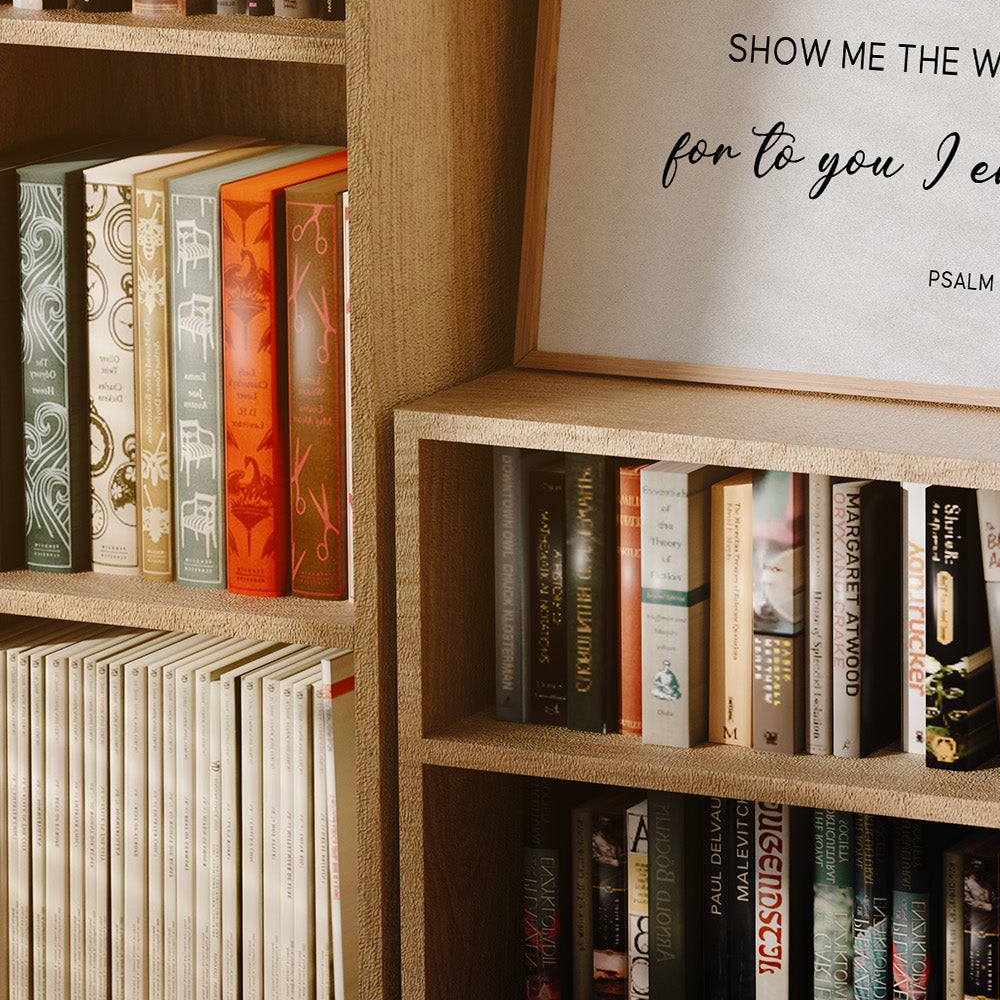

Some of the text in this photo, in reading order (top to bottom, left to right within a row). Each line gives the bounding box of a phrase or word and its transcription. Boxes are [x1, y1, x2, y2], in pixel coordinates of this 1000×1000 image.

[729, 34, 831, 67] SHOW
[842, 41, 885, 71] ME
[899, 44, 959, 75] THE
[662, 132, 741, 188] for
[752, 122, 805, 178] to
[809, 150, 904, 199] you
[923, 132, 960, 190] I
[929, 270, 993, 291] PSALM
[501, 454, 514, 528] DOWNTOWN
[502, 530, 513, 557] OWL
[834, 492, 846, 669] ORYX AND CRAKE
[846, 492, 860, 697] MARGARET ATWOOD
[501, 609, 514, 691] KLOSTERMAN
[723, 725, 738, 740] M
[710, 884, 723, 916] PAUL
